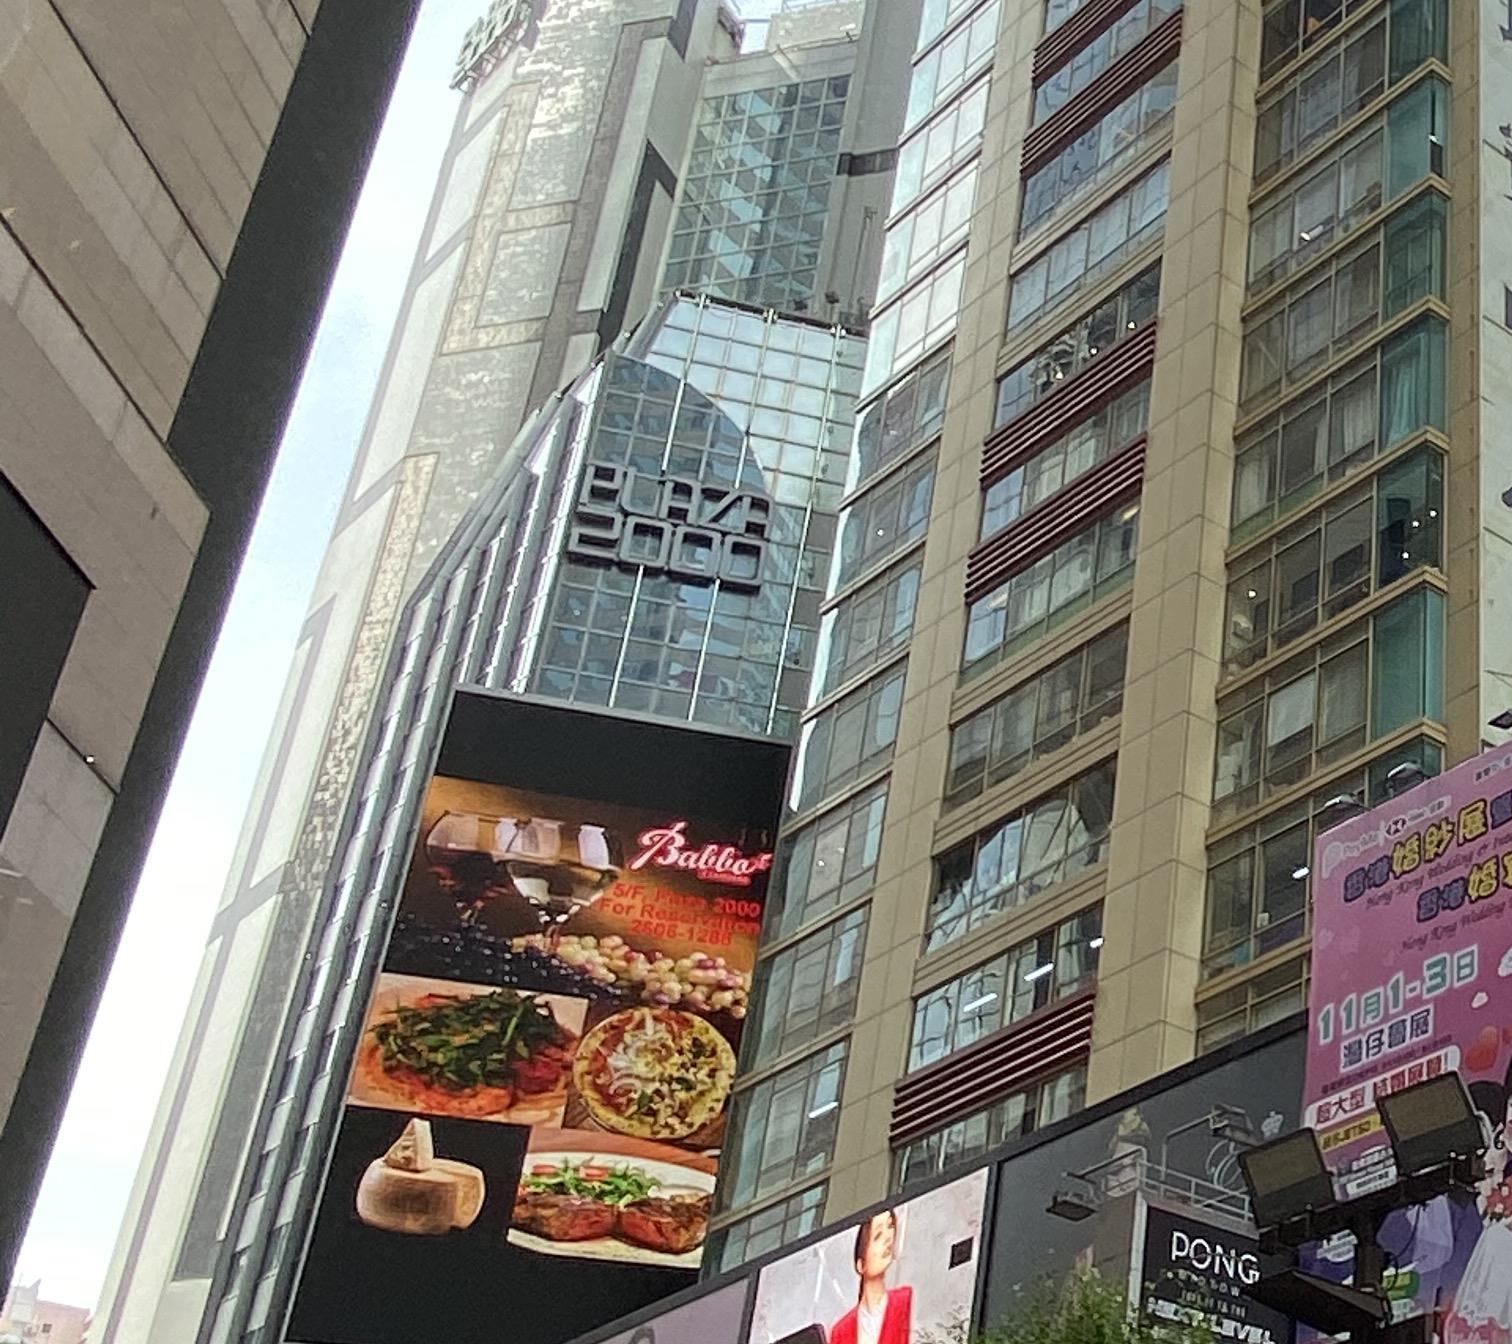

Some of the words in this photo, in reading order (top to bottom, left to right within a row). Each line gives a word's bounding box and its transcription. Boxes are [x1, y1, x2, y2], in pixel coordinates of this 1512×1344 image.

[599, 898, 633, 916] For
[1319, 946, 1477, 1043] 11月1-3日
[1171, 1230, 1261, 1285] PONG
